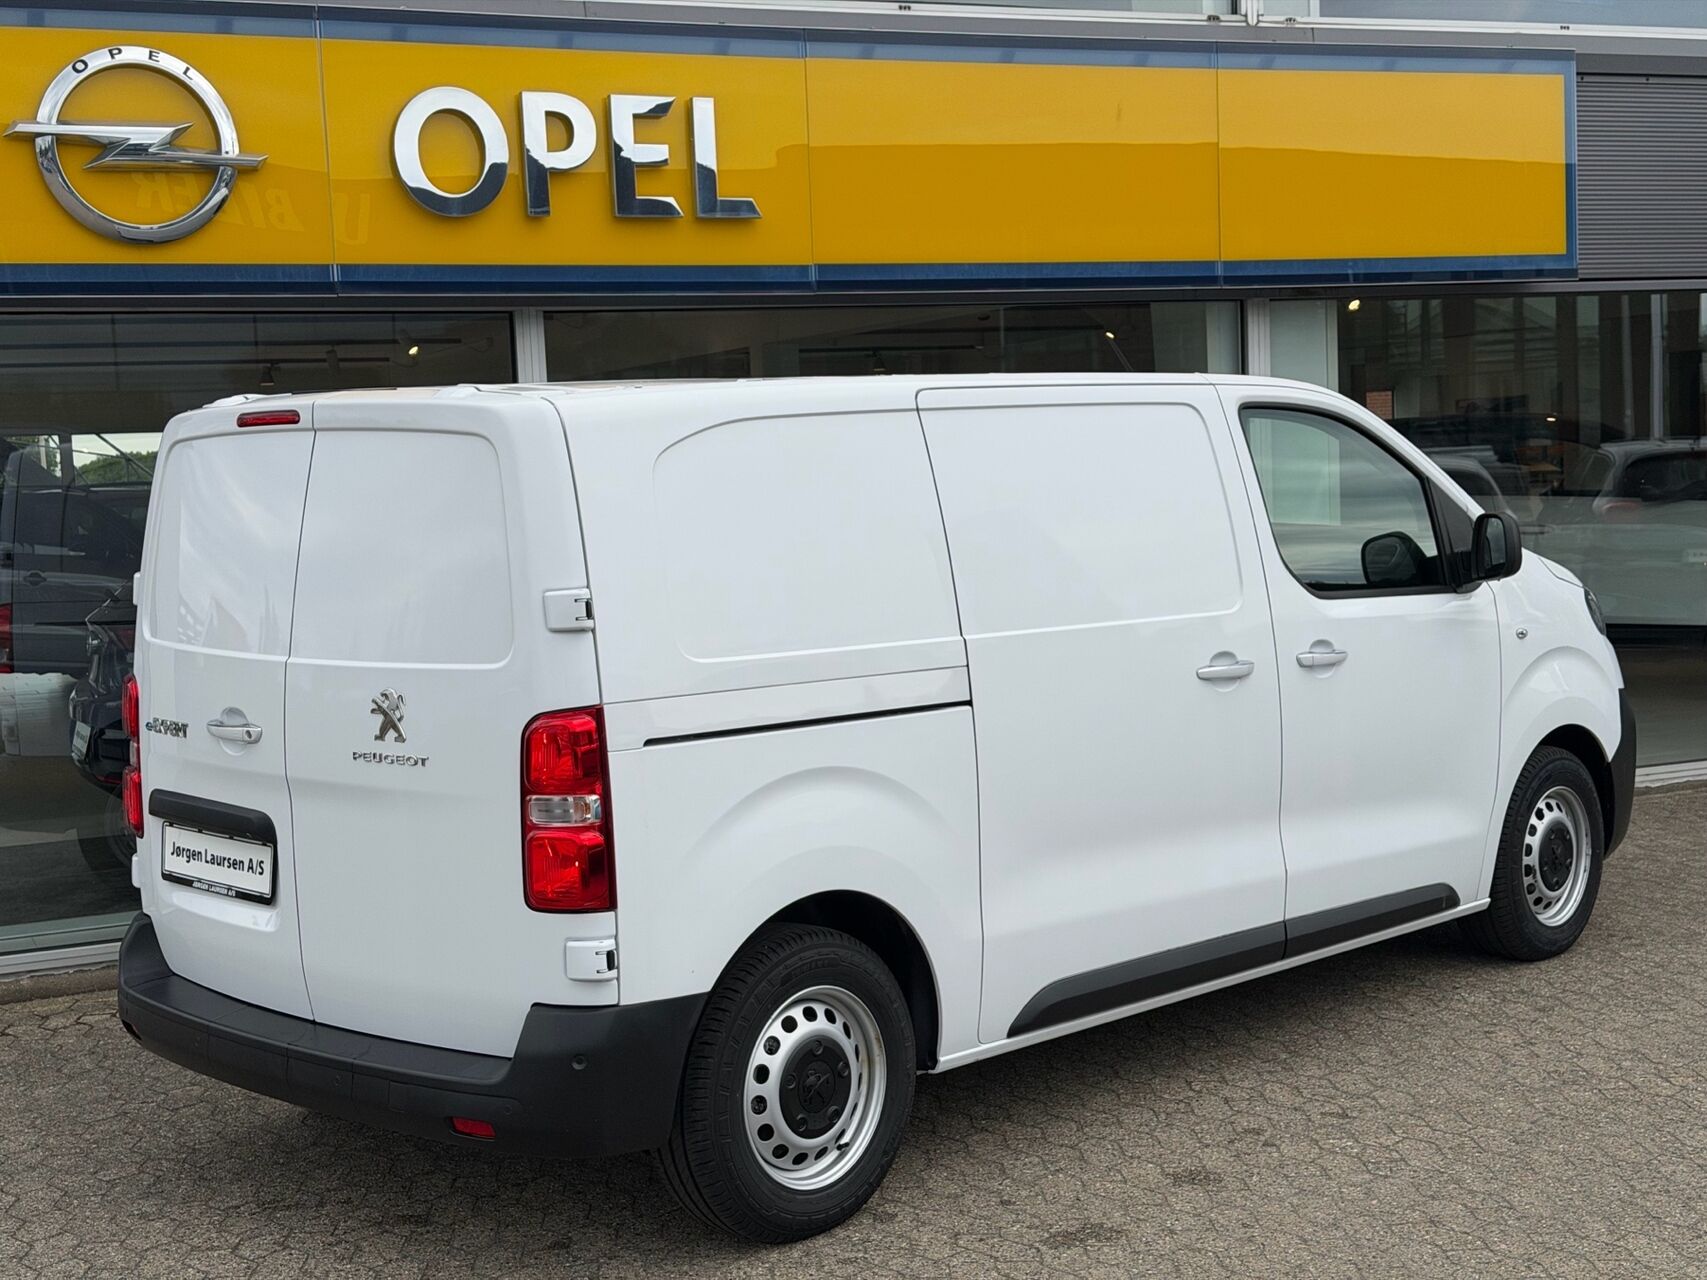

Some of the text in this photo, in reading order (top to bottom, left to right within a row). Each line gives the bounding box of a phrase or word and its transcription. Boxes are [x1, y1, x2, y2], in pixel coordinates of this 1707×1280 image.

[71, 47, 194, 80] OPEL
[393, 85, 762, 218] OPEL
[352, 751, 430, 767] PEUGEOT
[170, 841, 266, 876] Jørgen Laursen A/S
